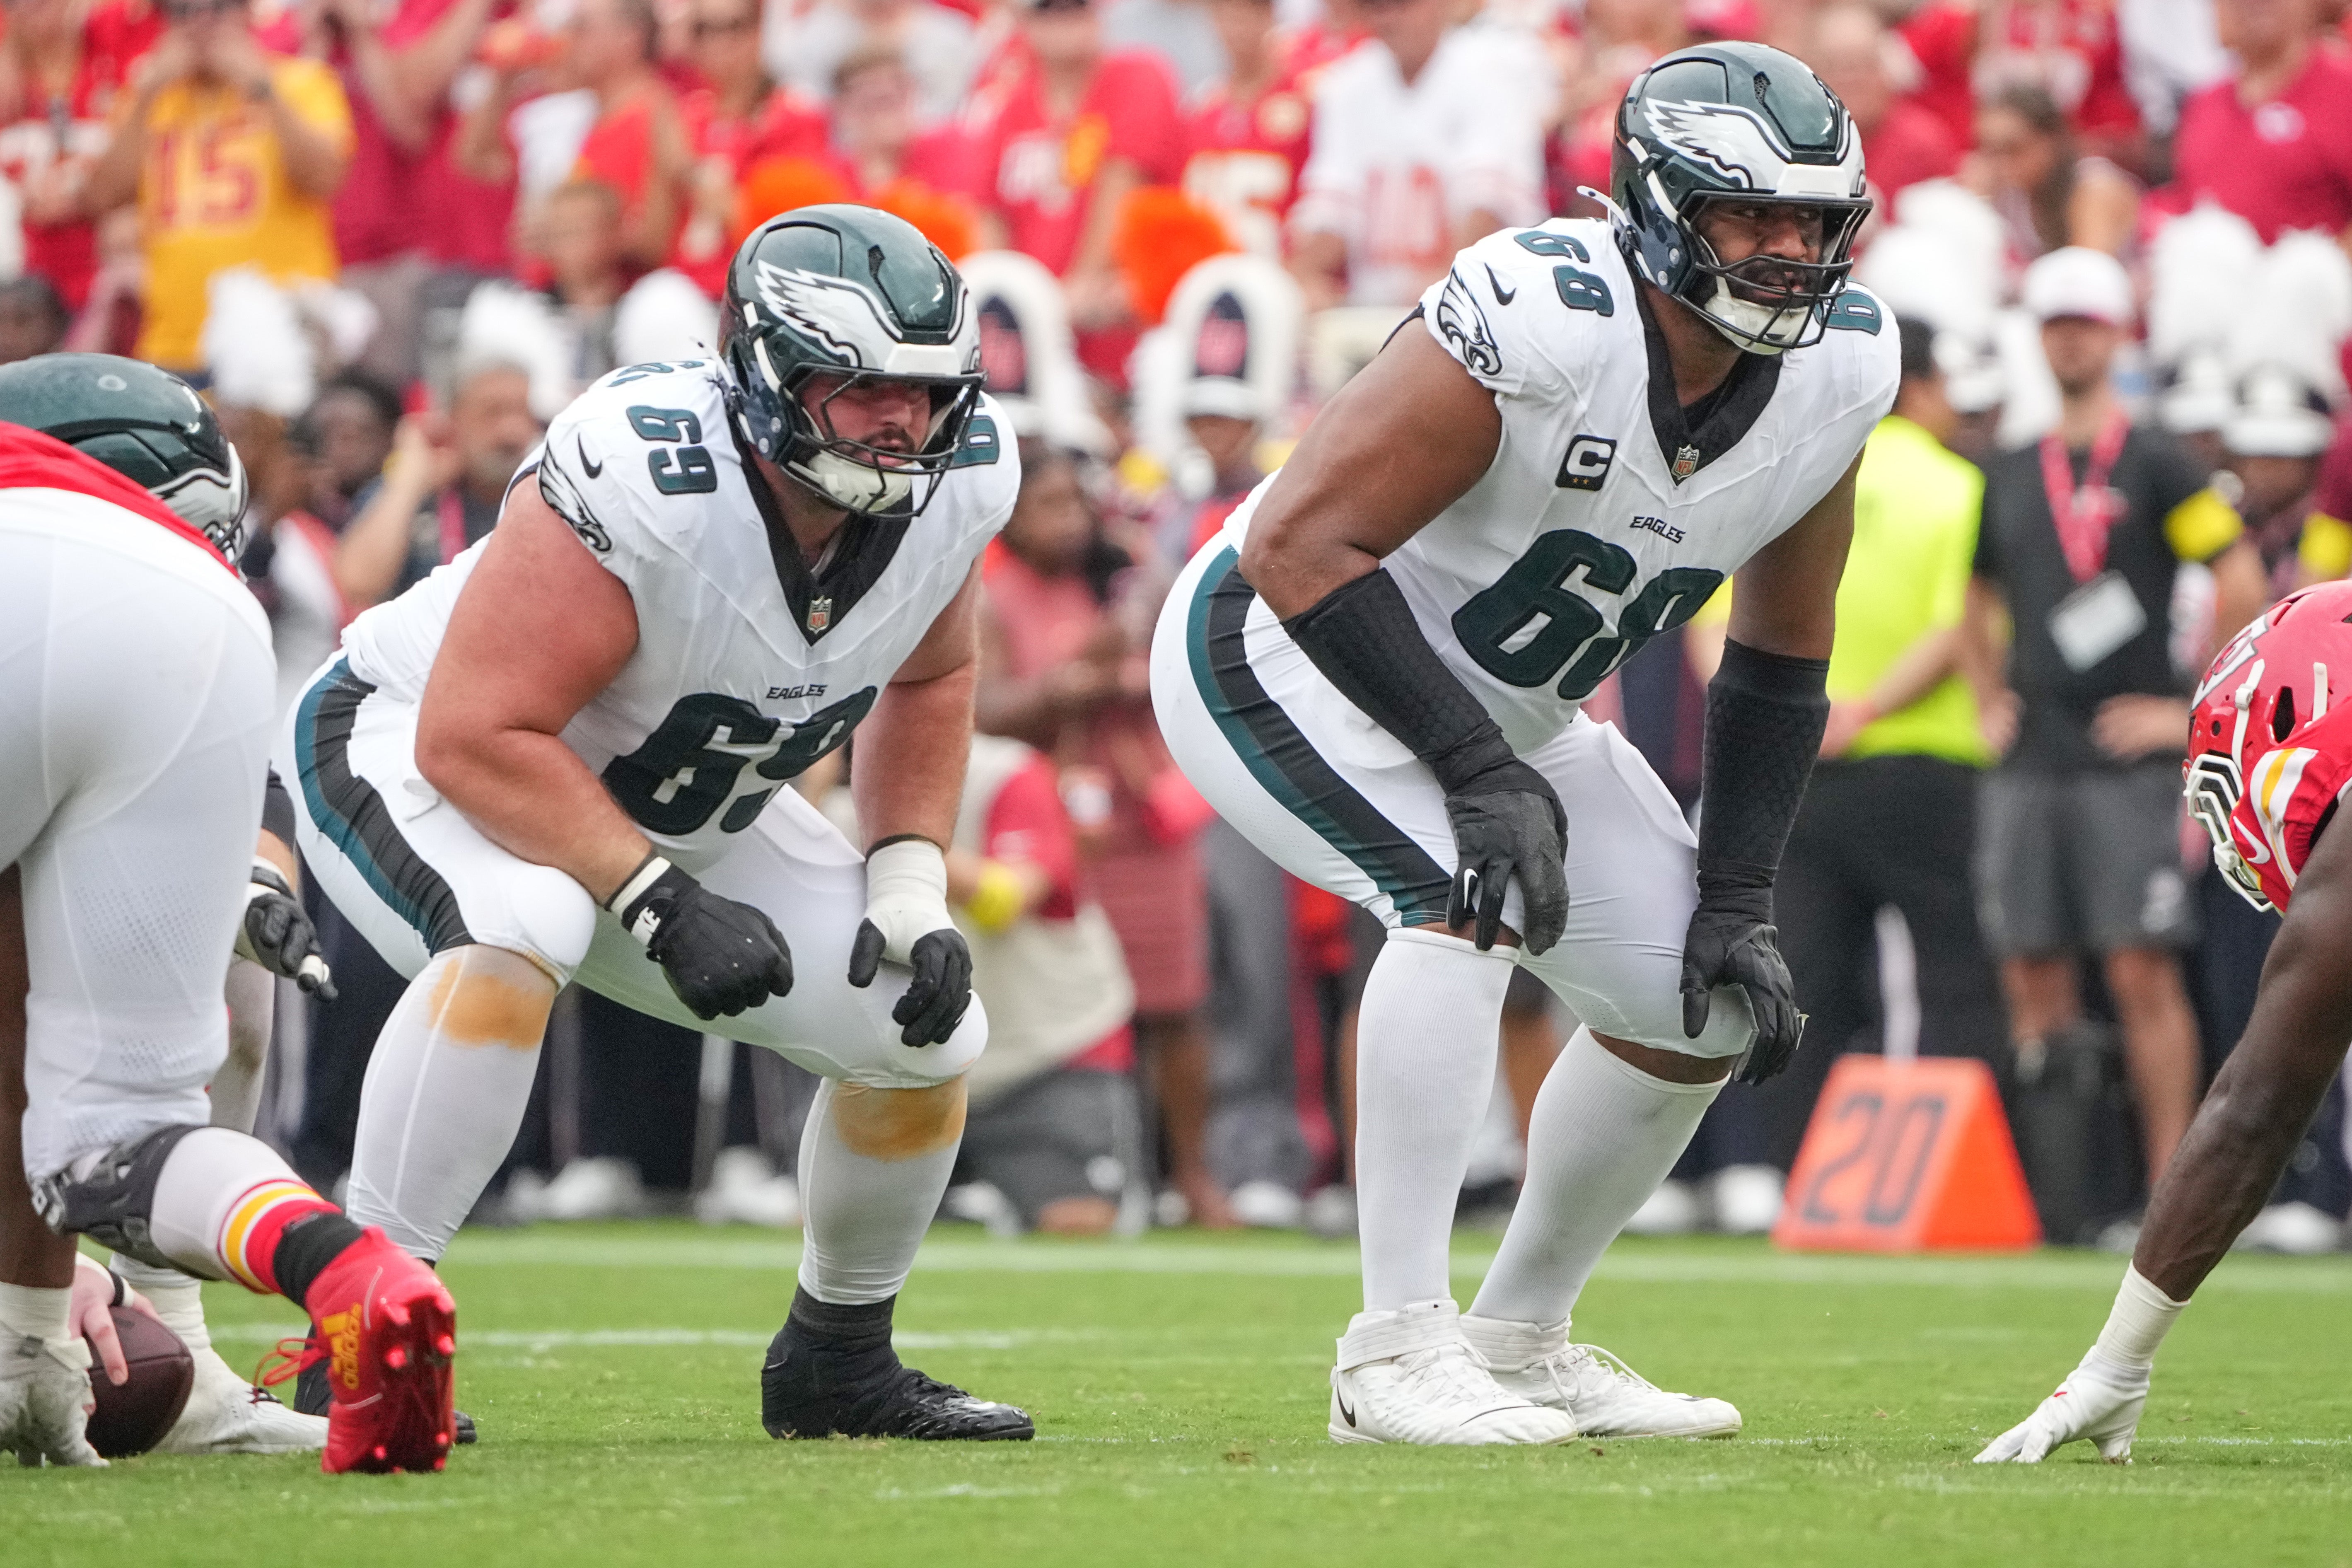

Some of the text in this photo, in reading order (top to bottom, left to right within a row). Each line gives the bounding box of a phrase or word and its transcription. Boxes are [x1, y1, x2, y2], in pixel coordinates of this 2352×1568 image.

[1514, 230, 1614, 317] 68
[626, 405, 717, 495] 69
[1566, 440, 1612, 477] C
[1630, 516, 1686, 544] EAGLES
[1451, 529, 1724, 700] 68
[766, 684, 828, 699] EAGLES
[601, 686, 877, 836] 69
[1802, 1093, 1945, 1226] 20
